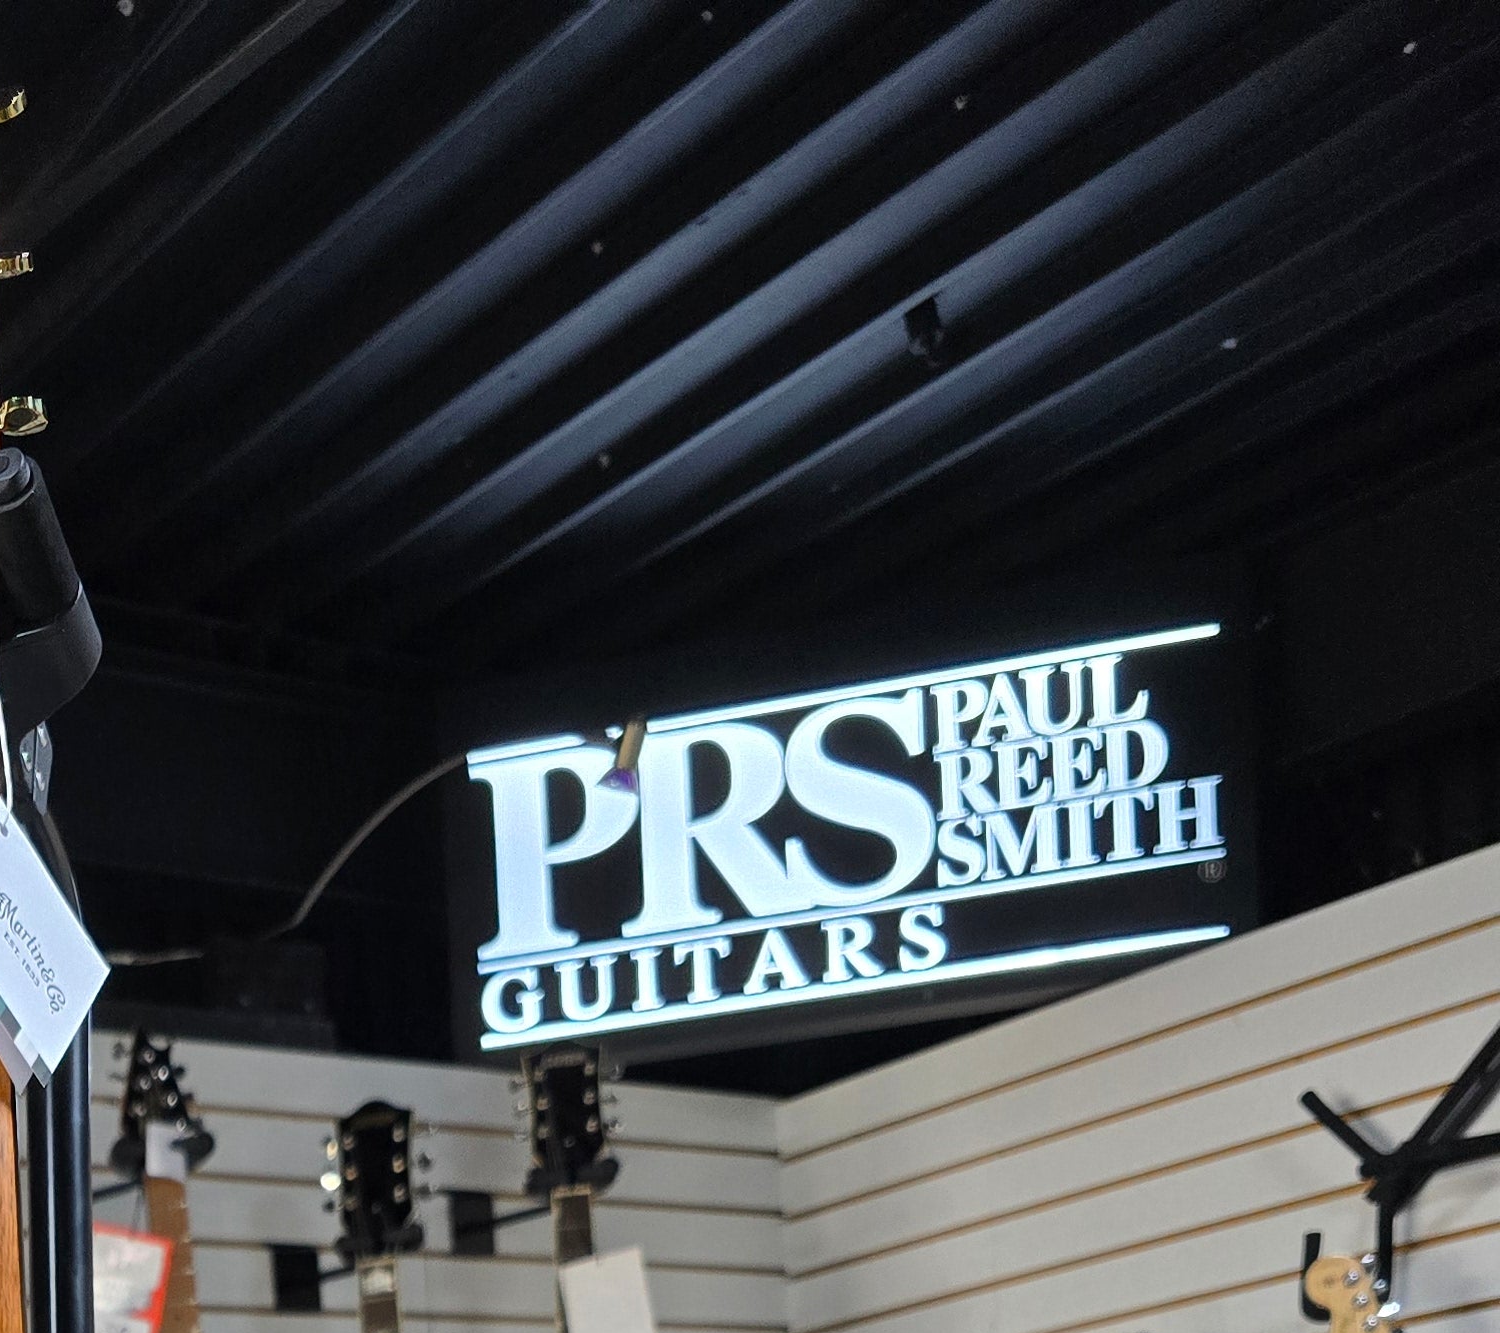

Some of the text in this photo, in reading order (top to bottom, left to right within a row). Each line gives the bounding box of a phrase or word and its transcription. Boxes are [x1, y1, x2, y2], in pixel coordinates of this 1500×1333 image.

[931, 653, 1150, 755] PAUL
[468, 687, 937, 961] PRS
[933, 718, 1170, 822] REED
[936, 774, 1226, 890] SMITH
[481, 903, 948, 1034] GUITARS
